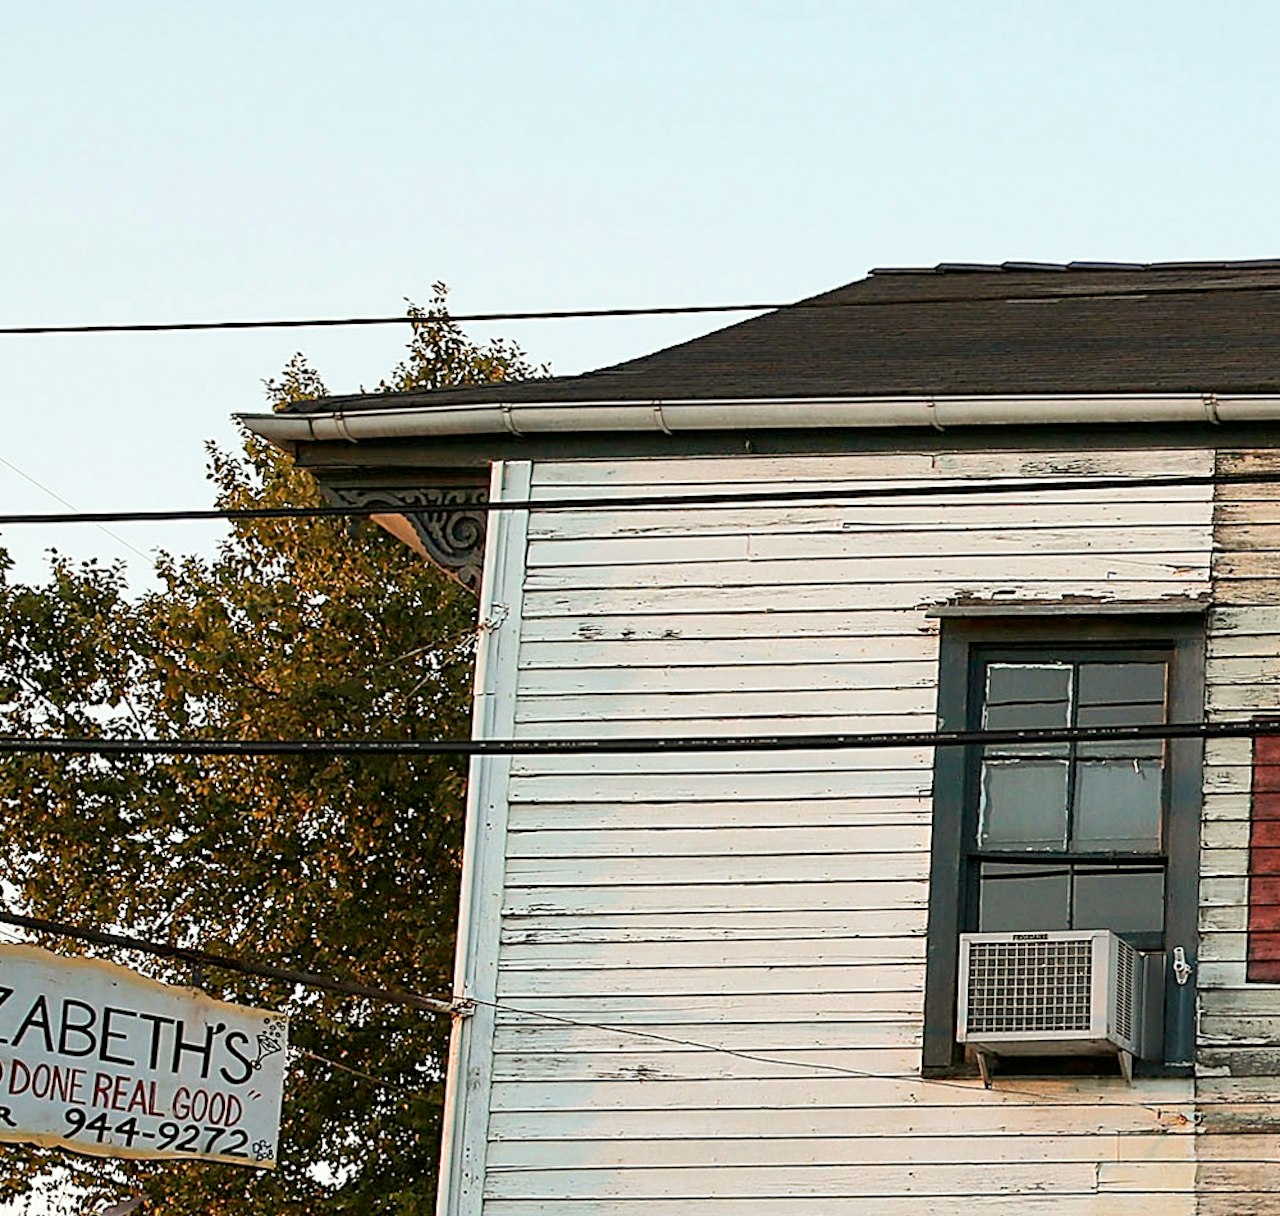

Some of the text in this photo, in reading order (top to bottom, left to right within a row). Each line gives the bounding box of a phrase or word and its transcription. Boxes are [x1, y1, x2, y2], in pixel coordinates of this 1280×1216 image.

[8, 1058, 87, 1105] DONE
[93, 1072, 165, 1119] REAL
[63, 1107, 249, 1158] 944-9272
